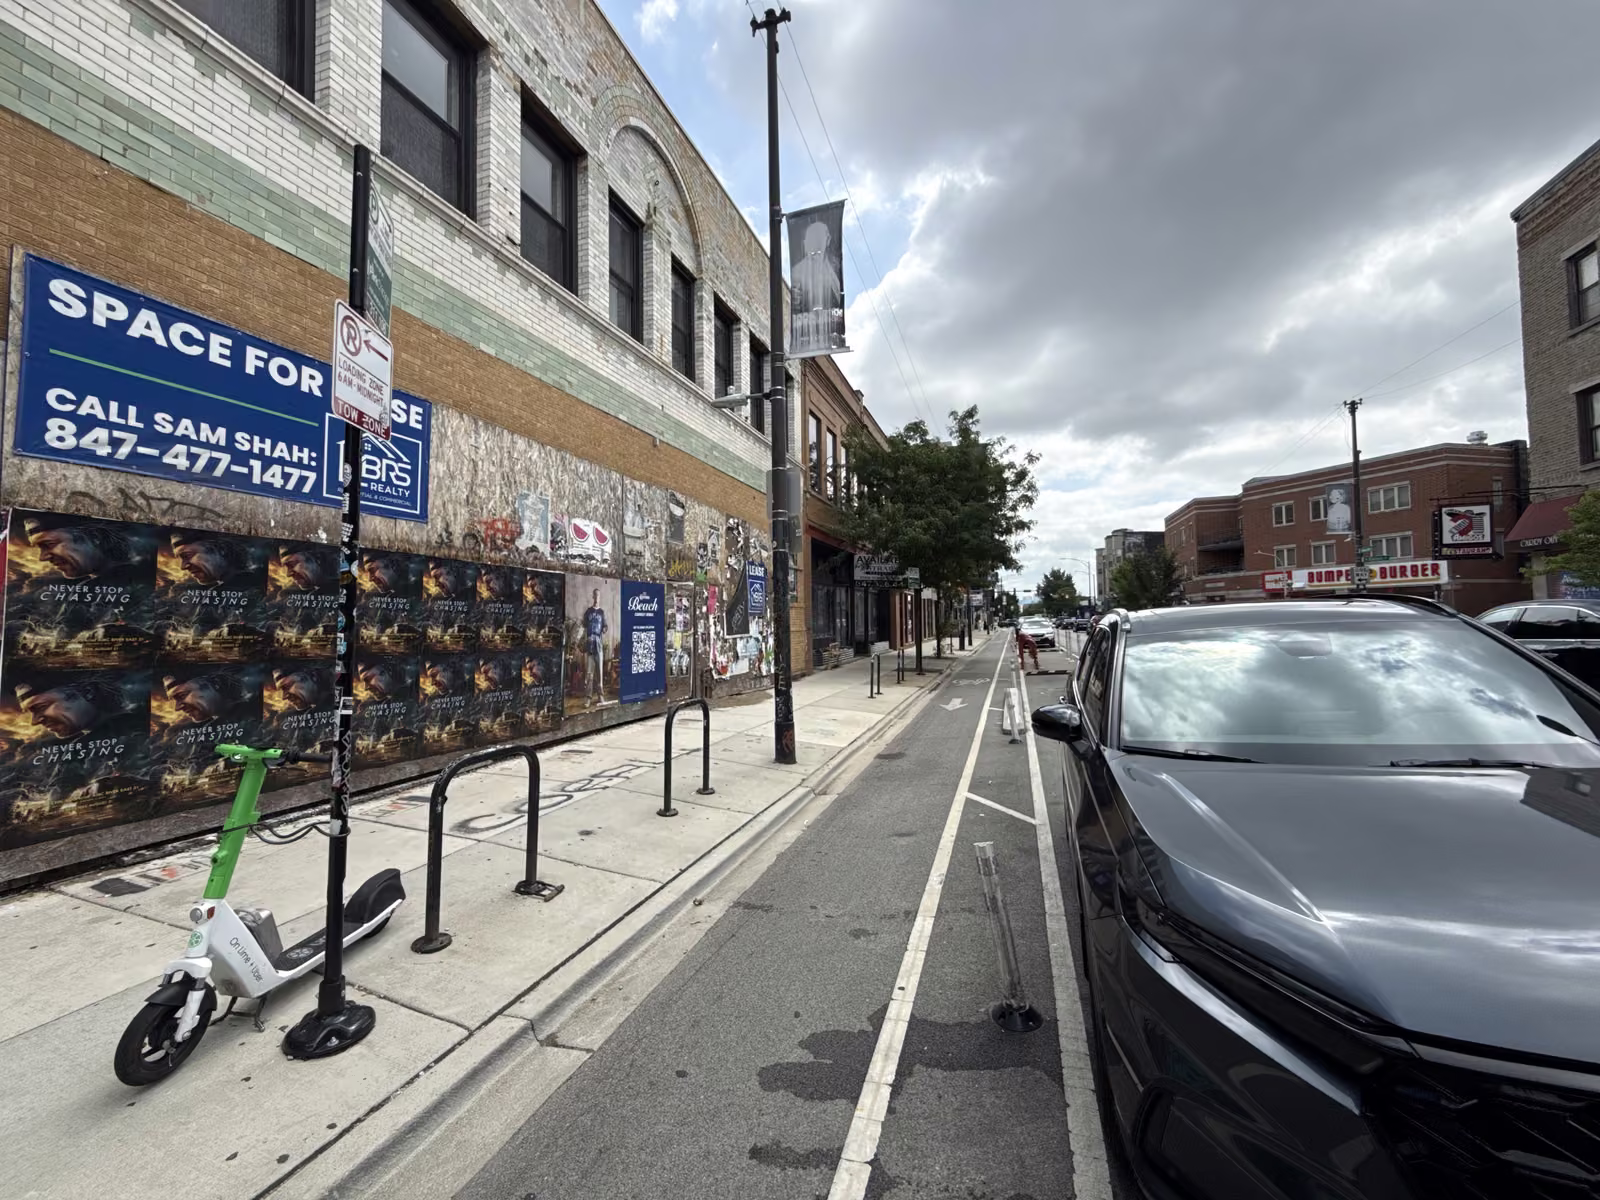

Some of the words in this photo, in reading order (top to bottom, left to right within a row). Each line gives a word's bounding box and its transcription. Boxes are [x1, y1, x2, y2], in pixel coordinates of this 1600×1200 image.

[48, 279, 232, 367] SPACE
[245, 345, 323, 397] FOR
[338, 358, 367, 388] LOADING
[368, 376, 384, 396] ZONE
[337, 400, 358, 424] TOW
[362, 413, 387, 439] ZONE
[46, 388, 144, 429] CALL
[153, 413, 226, 447] SAM
[234, 432, 317, 467] SHAH:
[44, 417, 317, 494] 847-477-1477
[371, 483, 411, 498] REALTY
[749, 565, 765, 577] LEASE
[1307, 569, 1353, 584] BUMPE
[48, 584, 89, 593] NEVER
[95, 585, 124, 594] STOP
[40, 592, 131, 603] CHASING
[181, 596, 248, 606] CHASING
[286, 600, 339, 608] CHASING
[628, 596, 658, 612] Beach
[368, 602, 410, 610] CHASING
[287, 714, 311, 722] NEVER
[364, 706, 407, 718] CHASING
[182, 727, 213, 736] NEVER
[216, 723, 239, 732] STOP
[282, 716, 336, 730] CHASING
[176, 729, 243, 745] CHASING
[41, 743, 83, 755] NEVER
[88, 738, 118, 749] STOP
[32, 744, 125, 765] CHASING
[229, 936, 241, 951] On
[237, 945, 251, 964] Lime
